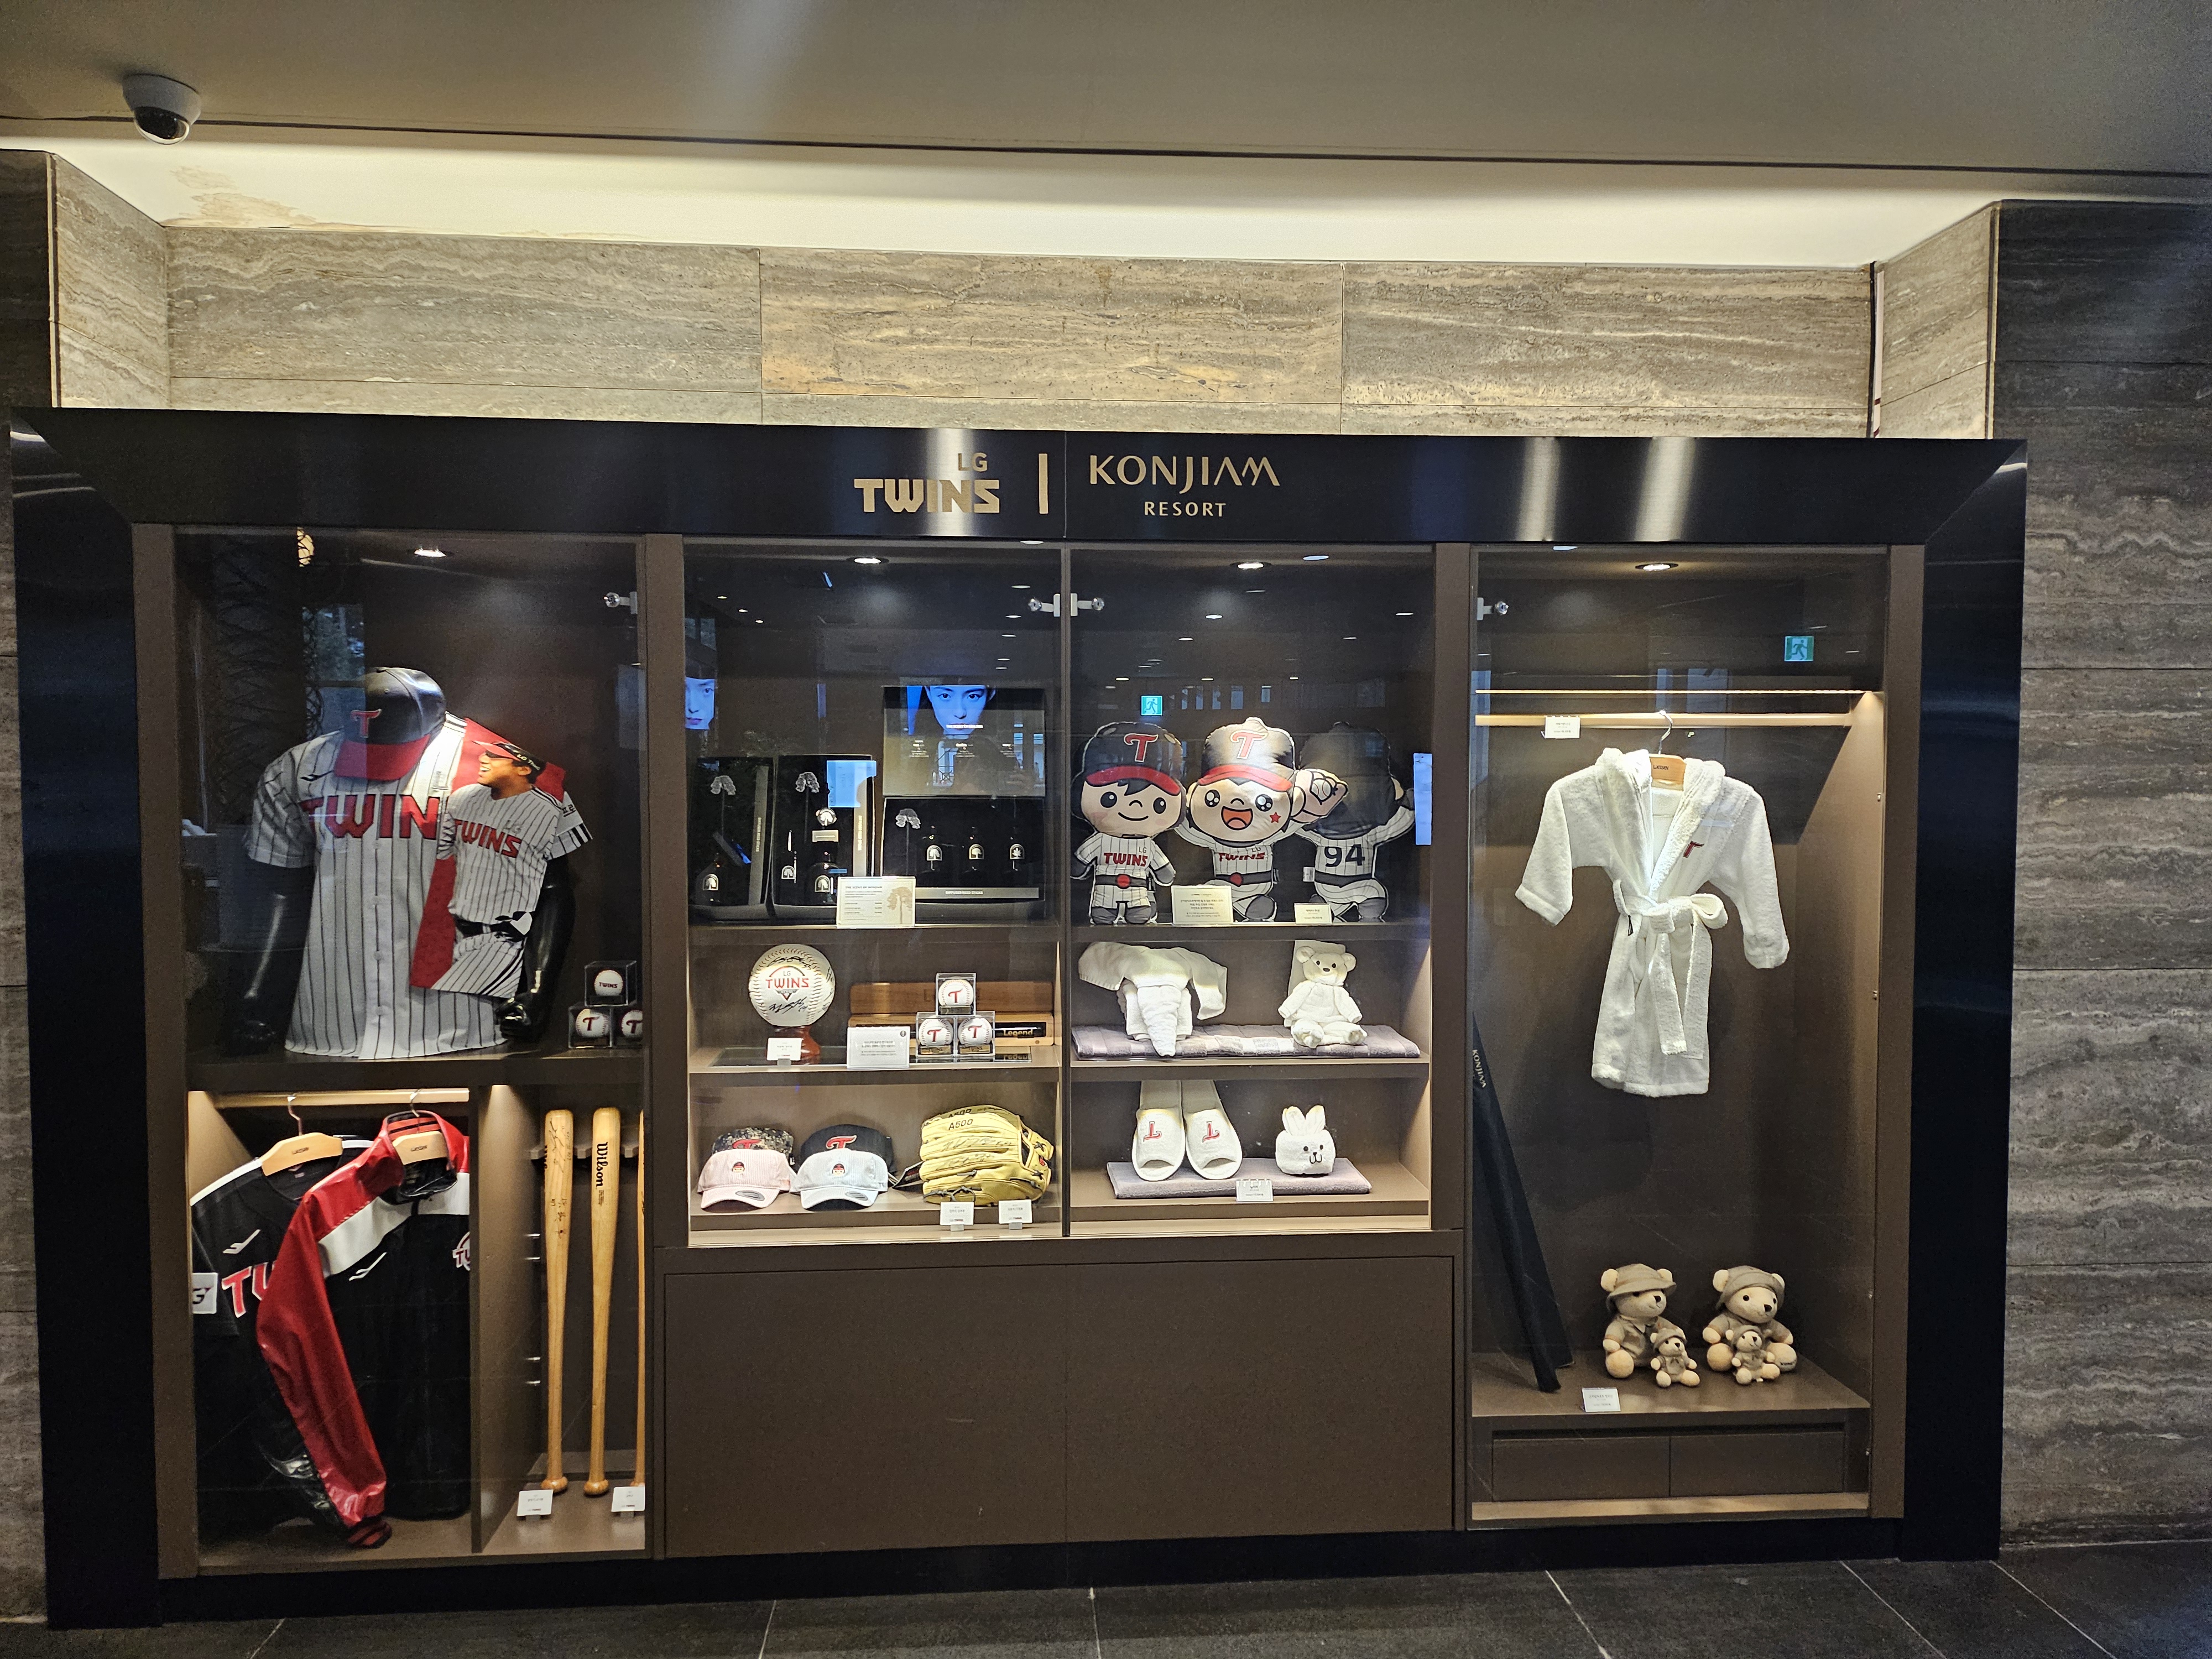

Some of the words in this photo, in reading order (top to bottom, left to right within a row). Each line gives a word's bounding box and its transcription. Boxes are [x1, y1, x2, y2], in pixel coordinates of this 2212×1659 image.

[958, 452, 988, 472] LG
[1089, 455, 1280, 494] KONJIAM
[854, 479, 1000, 514] TWINS
[1144, 501, 1227, 517] RESORT
[351, 709, 382, 738] T
[1124, 733, 1159, 763] T
[1230, 729, 1268, 759] T
[454, 818, 521, 858] TWINS
[1104, 853, 1148, 867] TWINS
[1324, 844, 1365, 867] 94
[765, 977, 809, 988] TWINS
[948, 988, 963, 1003] T
[582, 1016, 600, 1031] T
[626, 1020, 643, 1034] T
[968, 1025, 983, 1039] T
[927, 1027, 943, 1042] T
[1472, 1049, 1486, 1088] KONJIAM
[948, 1119, 973, 1130] A500
[826, 1135, 857, 1149] T
[596, 1142, 608, 1187] Wilson
